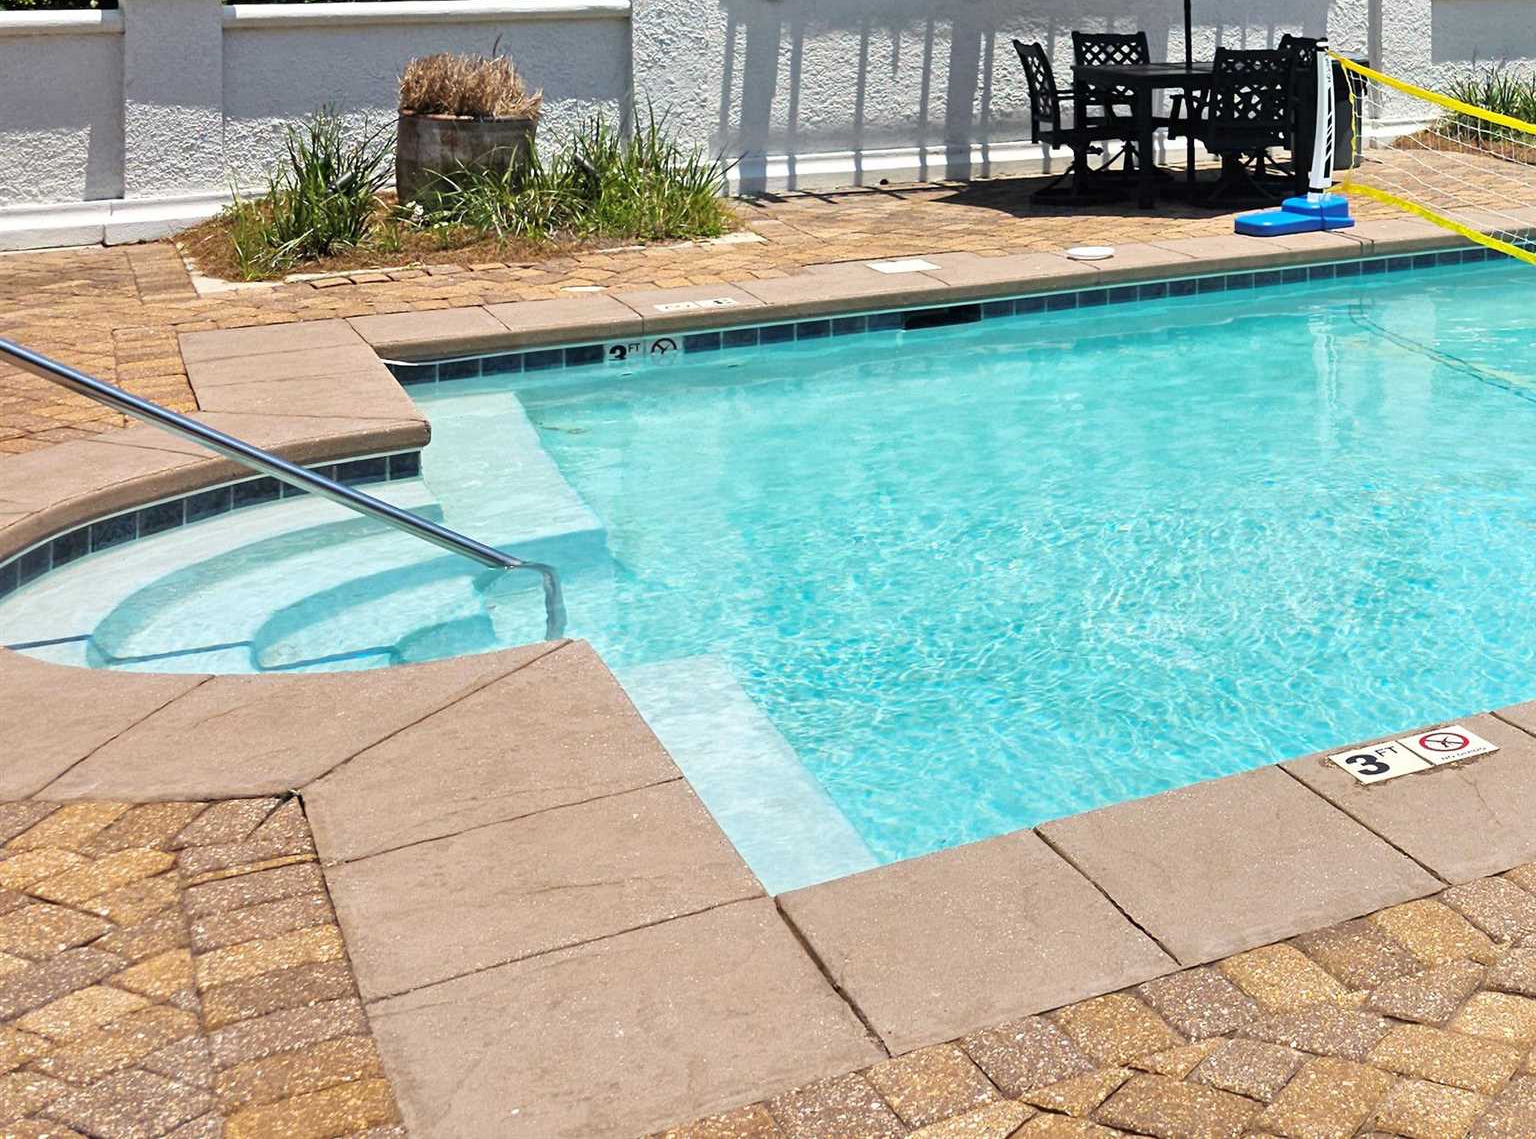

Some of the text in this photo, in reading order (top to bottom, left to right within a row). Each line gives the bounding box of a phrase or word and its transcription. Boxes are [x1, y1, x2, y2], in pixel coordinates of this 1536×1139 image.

[628, 342, 641, 353] FT
[1345, 745, 1399, 776] 3 FT
